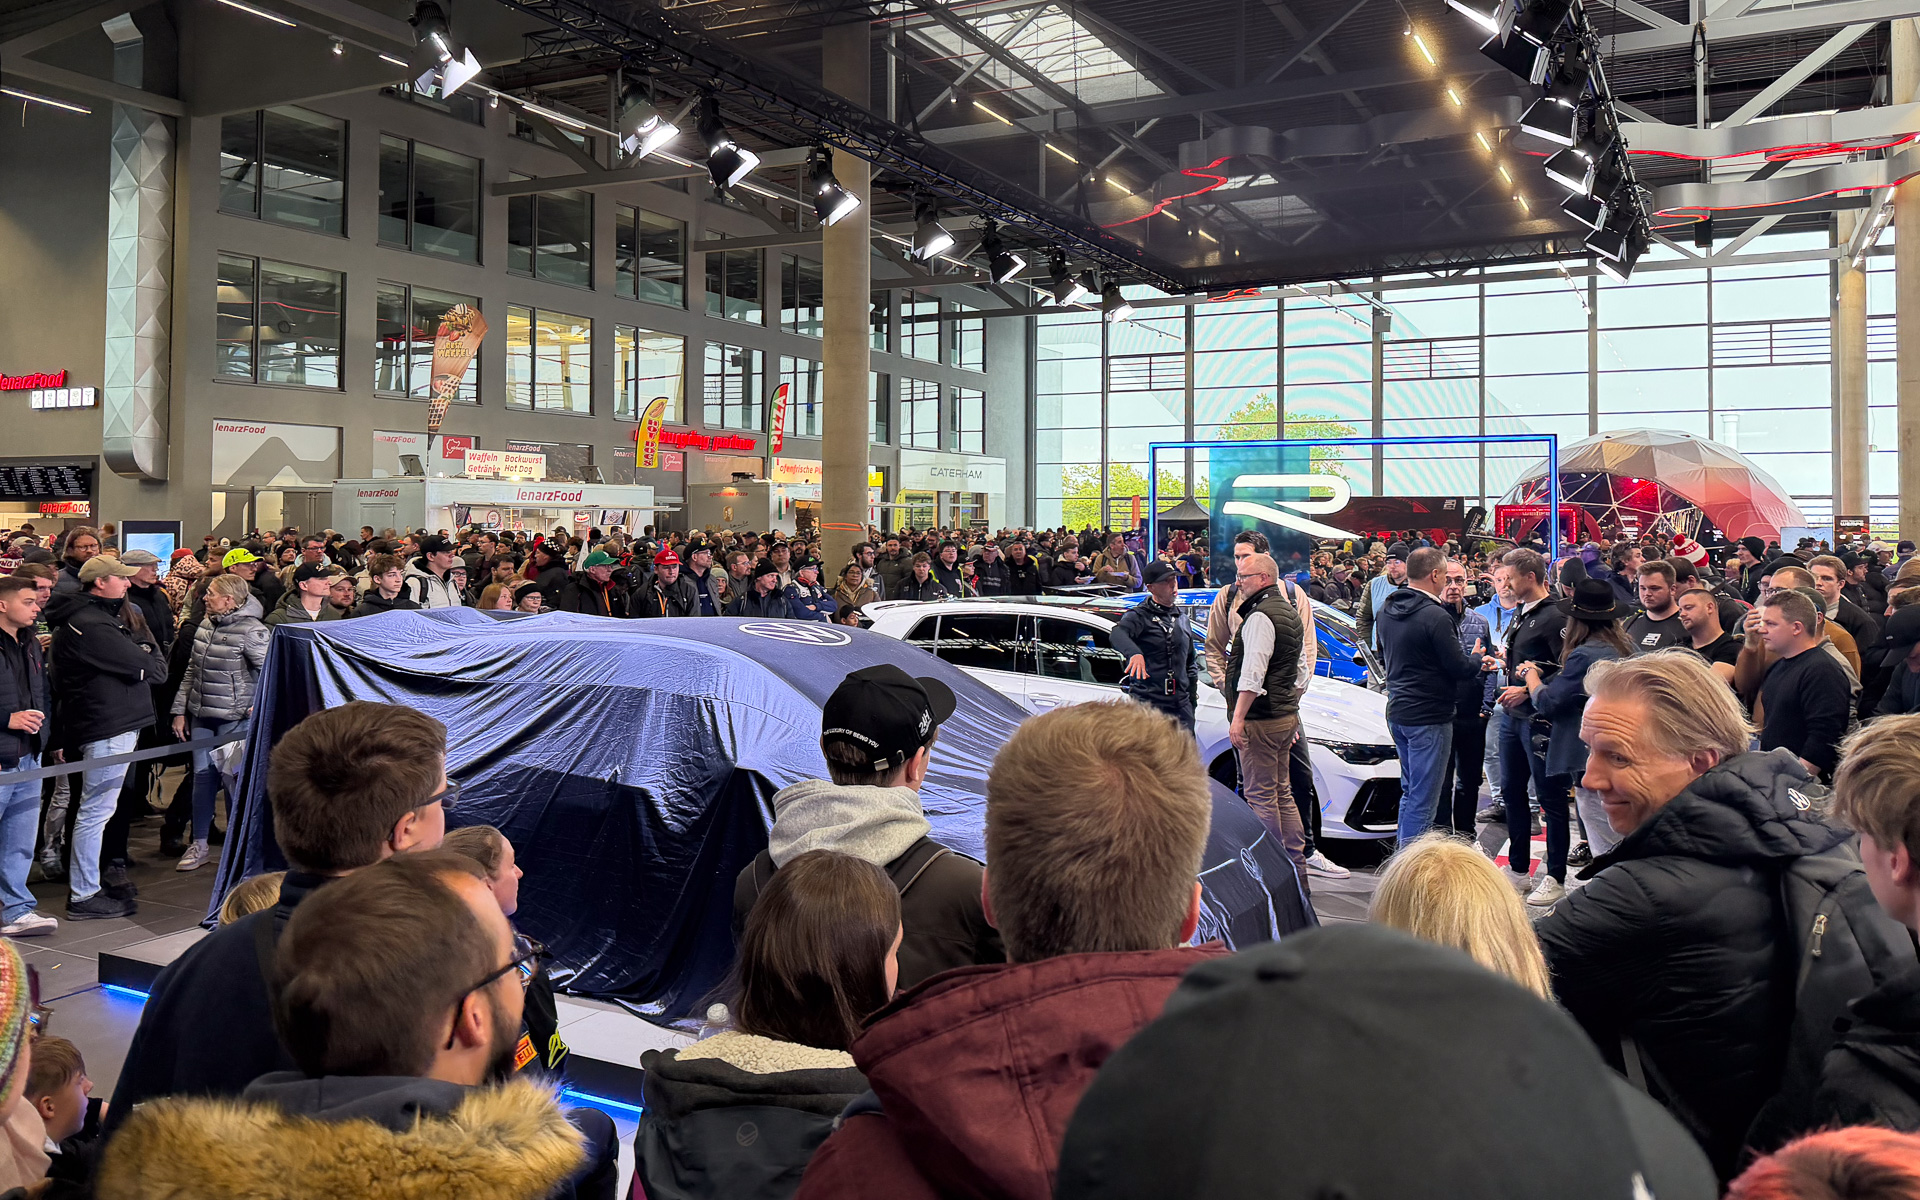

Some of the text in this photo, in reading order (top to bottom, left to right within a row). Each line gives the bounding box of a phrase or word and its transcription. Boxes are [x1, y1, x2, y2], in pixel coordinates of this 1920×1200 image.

[437, 348, 471, 358] WAFFEL
[770, 394, 786, 446] PIZZA
[215, 423, 266, 434] lenarzFood
[506, 443, 541, 452] lenarzFood
[643, 419, 659, 467] HOT DOGS
[712, 434, 757, 451] partner
[469, 453, 543, 464] Waffeln Bockwurst
[468, 464, 500, 473] Getränke
[519, 465, 533, 475] Dog
[780, 464, 813, 475] ofenfrische
[930, 467, 982, 479] CATERHAM
[357, 488, 399, 498] lenarzFood
[516, 488, 583, 502] lenarzFood
[852, 731, 868, 742] BEING
[868, 738, 879, 748] YOU
